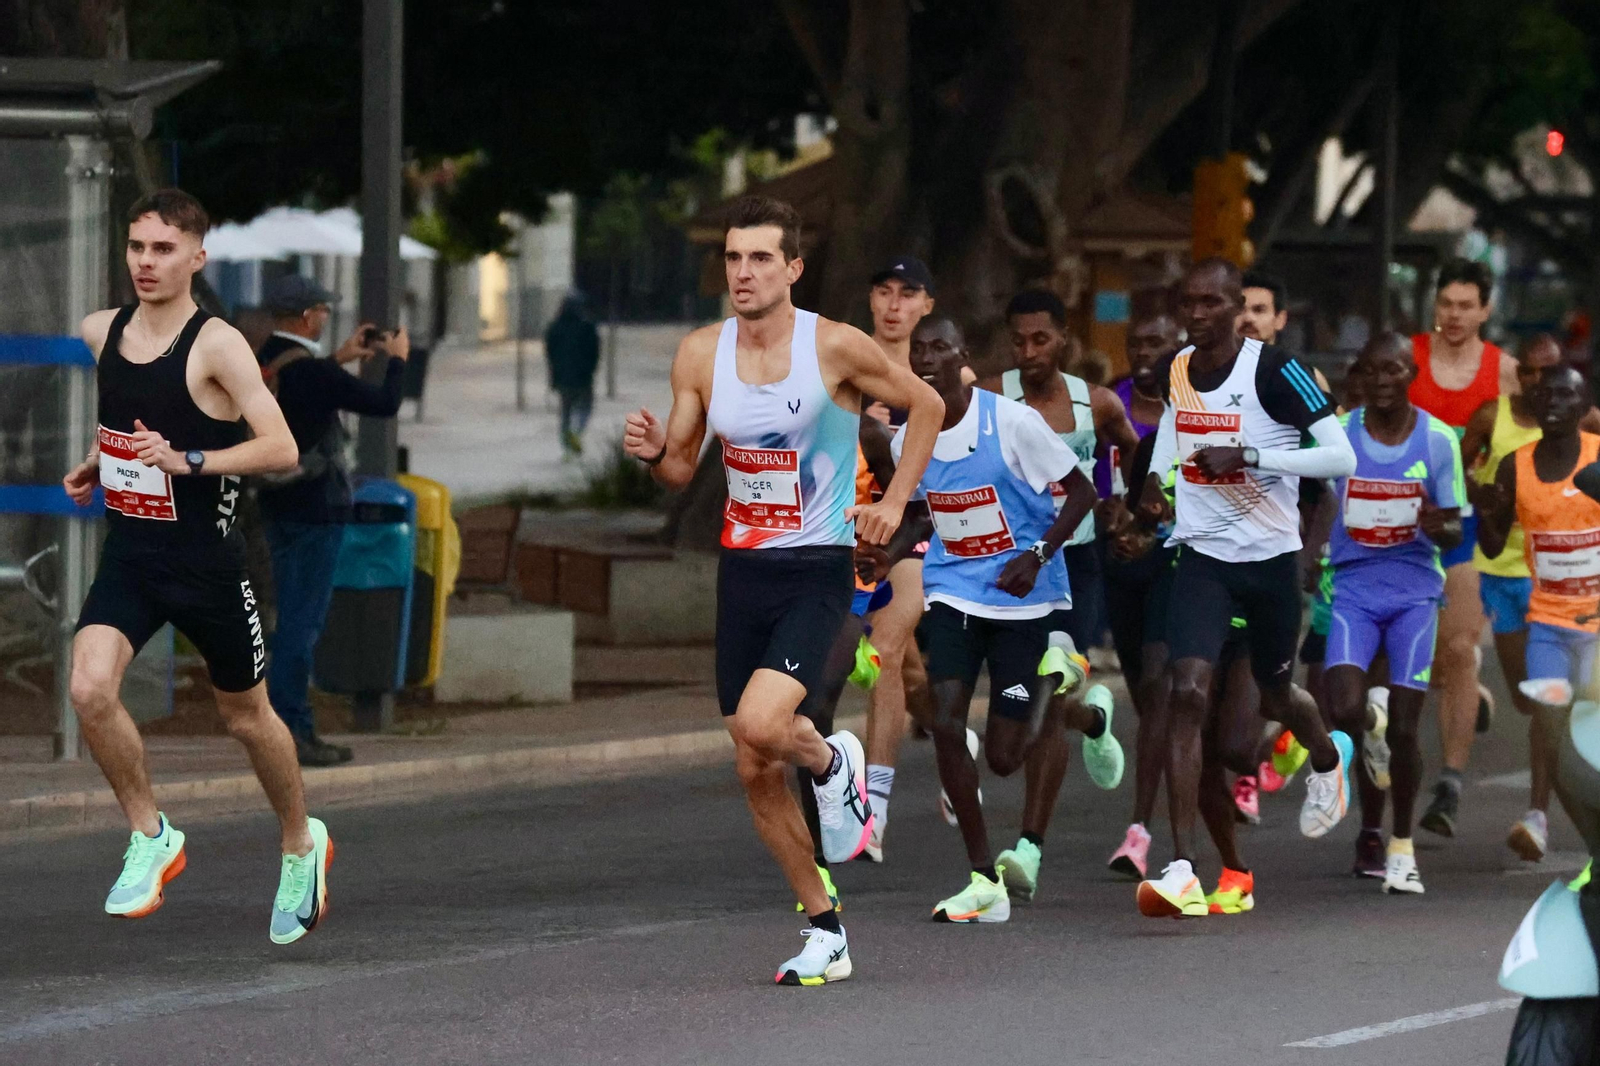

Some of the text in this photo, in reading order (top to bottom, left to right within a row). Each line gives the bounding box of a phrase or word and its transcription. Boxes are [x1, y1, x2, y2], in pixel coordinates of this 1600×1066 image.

[1187, 414, 1236, 428] GENERALI
[734, 450, 791, 465] GENERALI
[117, 467, 141, 480] PACER
[741, 478, 774, 492] PACER
[940, 489, 991, 505] GENERALI
[247, 610, 266, 680] TEAM
